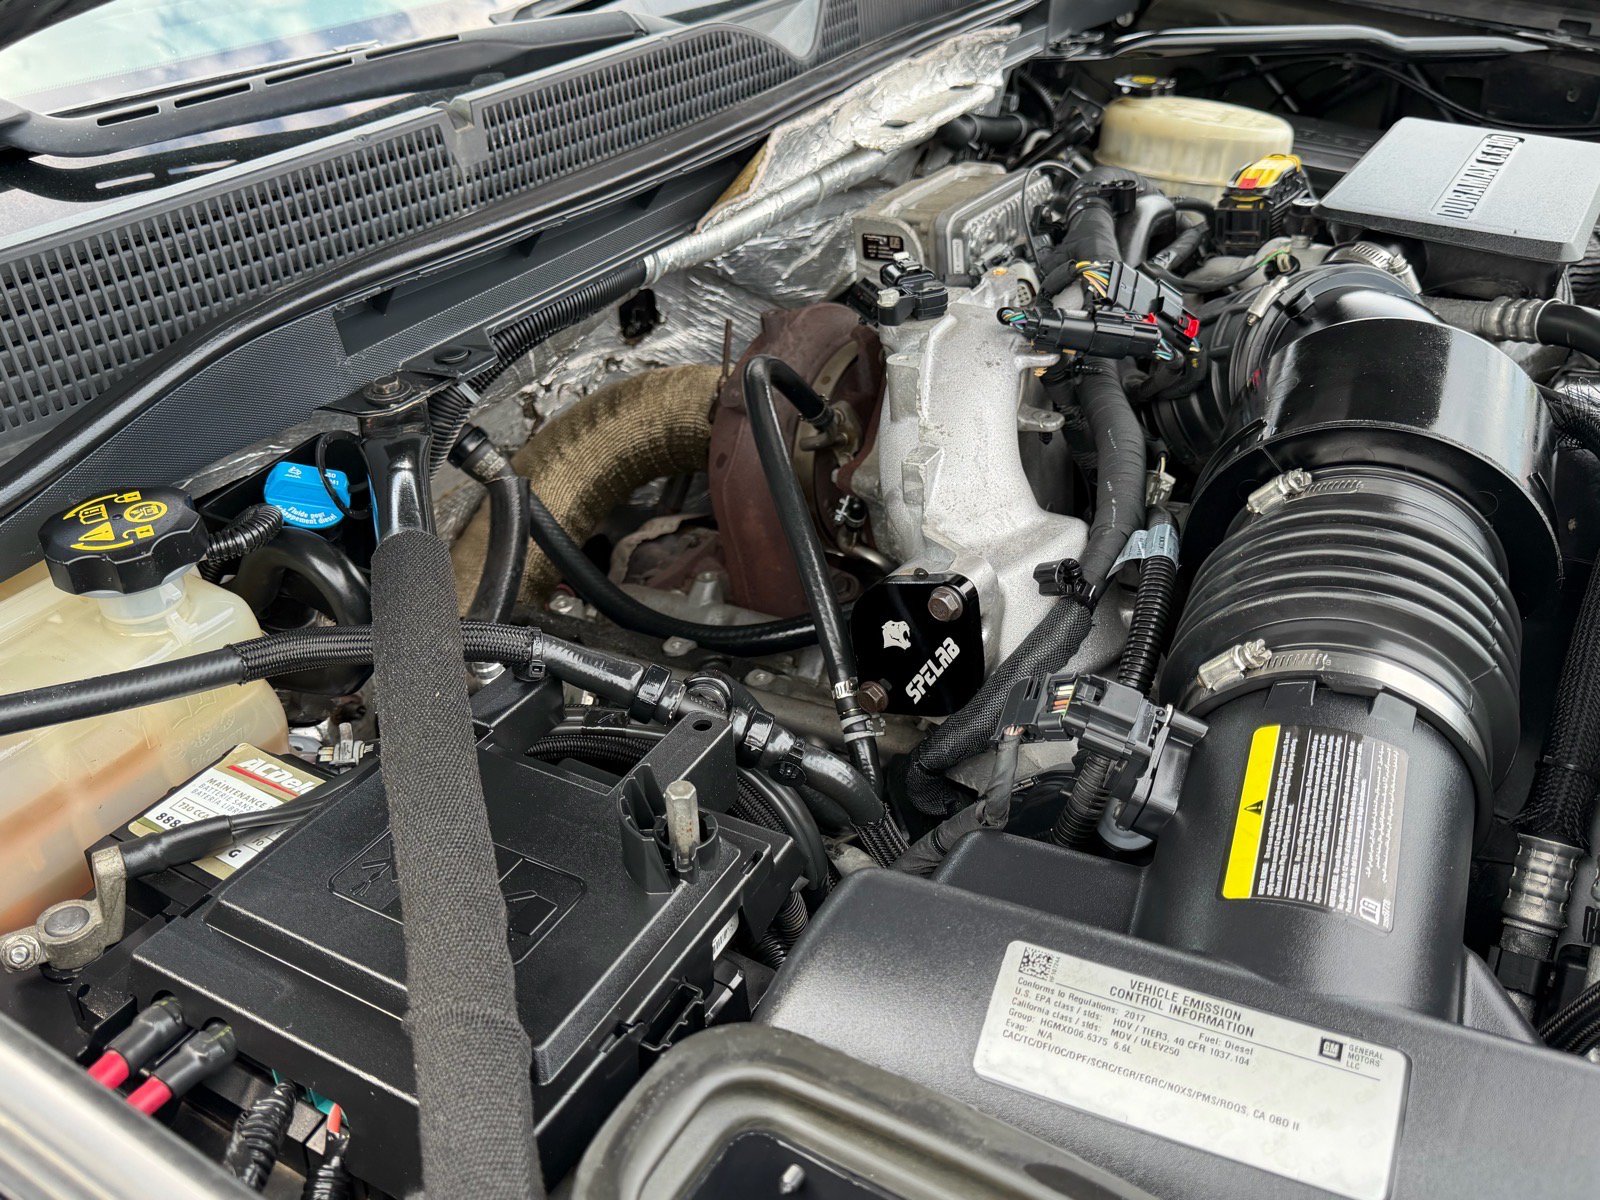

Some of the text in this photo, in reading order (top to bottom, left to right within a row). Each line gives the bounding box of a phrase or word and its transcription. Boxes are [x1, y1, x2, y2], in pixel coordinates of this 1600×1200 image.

[1437, 164, 1499, 220] DURAMAX
[905, 636, 960, 704] SPELAB
[177, 801, 192, 812] 730
[198, 783, 252, 812] BATTERIE SANS
[207, 777, 268, 808] MAINTENANCE
[1017, 977, 1146, 1022] Conforms to Regulations: 2017
[1109, 986, 1254, 1038] CONTROL INFORMATION
[1130, 979, 1241, 1022] VEHICLE EMISSION
[1005, 1018, 1052, 1040] Evap: N/A
[1008, 1008, 1035, 1023] Group:
[1113, 1041, 1132, 1054] 6.6L
[1011, 997, 1050, 1016] California
[1052, 1011, 1073, 1023] class
[1110, 1028, 1132, 1041] MDV
[1140, 1037, 1180, 1057] ULEV250
[1015, 986, 1031, 998] U.S.
[1035, 993, 1051, 1005] EPA
[1054, 1000, 1074, 1012] class
[1173, 1037, 1185, 1046] 40
[1187, 1040, 1206, 1053] CFR
[1210, 1048, 1250, 1066] 1037.104
[1198, 1032, 1254, 1055] Fuel: Diesel
[1346, 1060, 1360, 1070] LLC
[1348, 1052, 1380, 1068] MOTORS
[1349, 1045, 1384, 1061] GENERAL
